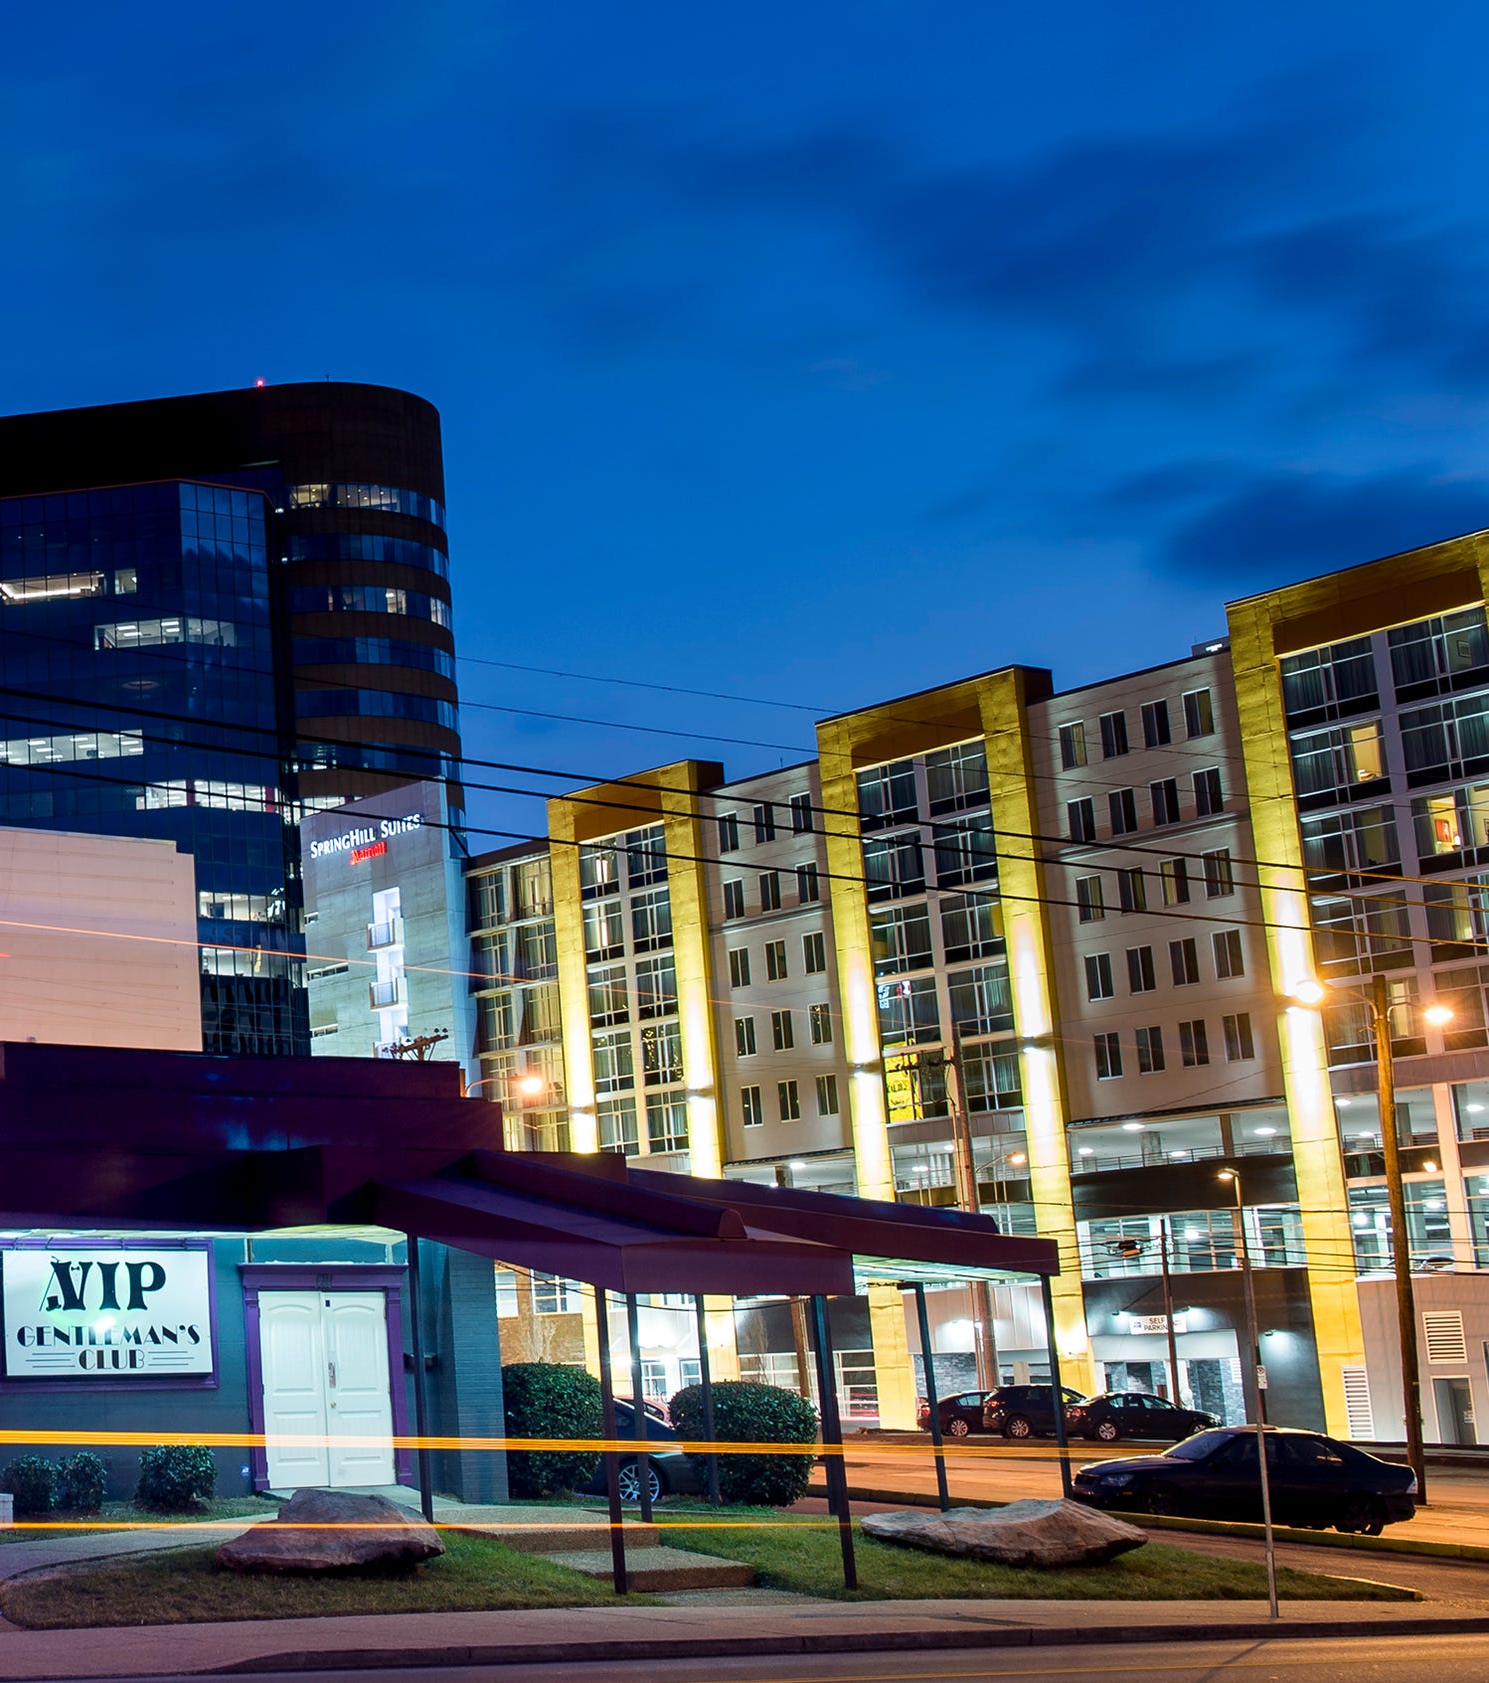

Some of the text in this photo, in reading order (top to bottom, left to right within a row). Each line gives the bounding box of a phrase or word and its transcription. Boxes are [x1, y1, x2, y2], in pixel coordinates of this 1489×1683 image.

[380, 814, 420, 838] SUITES
[50, 1261, 166, 1311] VIP
[16, 1325, 201, 1347] GENTLEMAN'S
[78, 1349, 145, 1370] CLUB
